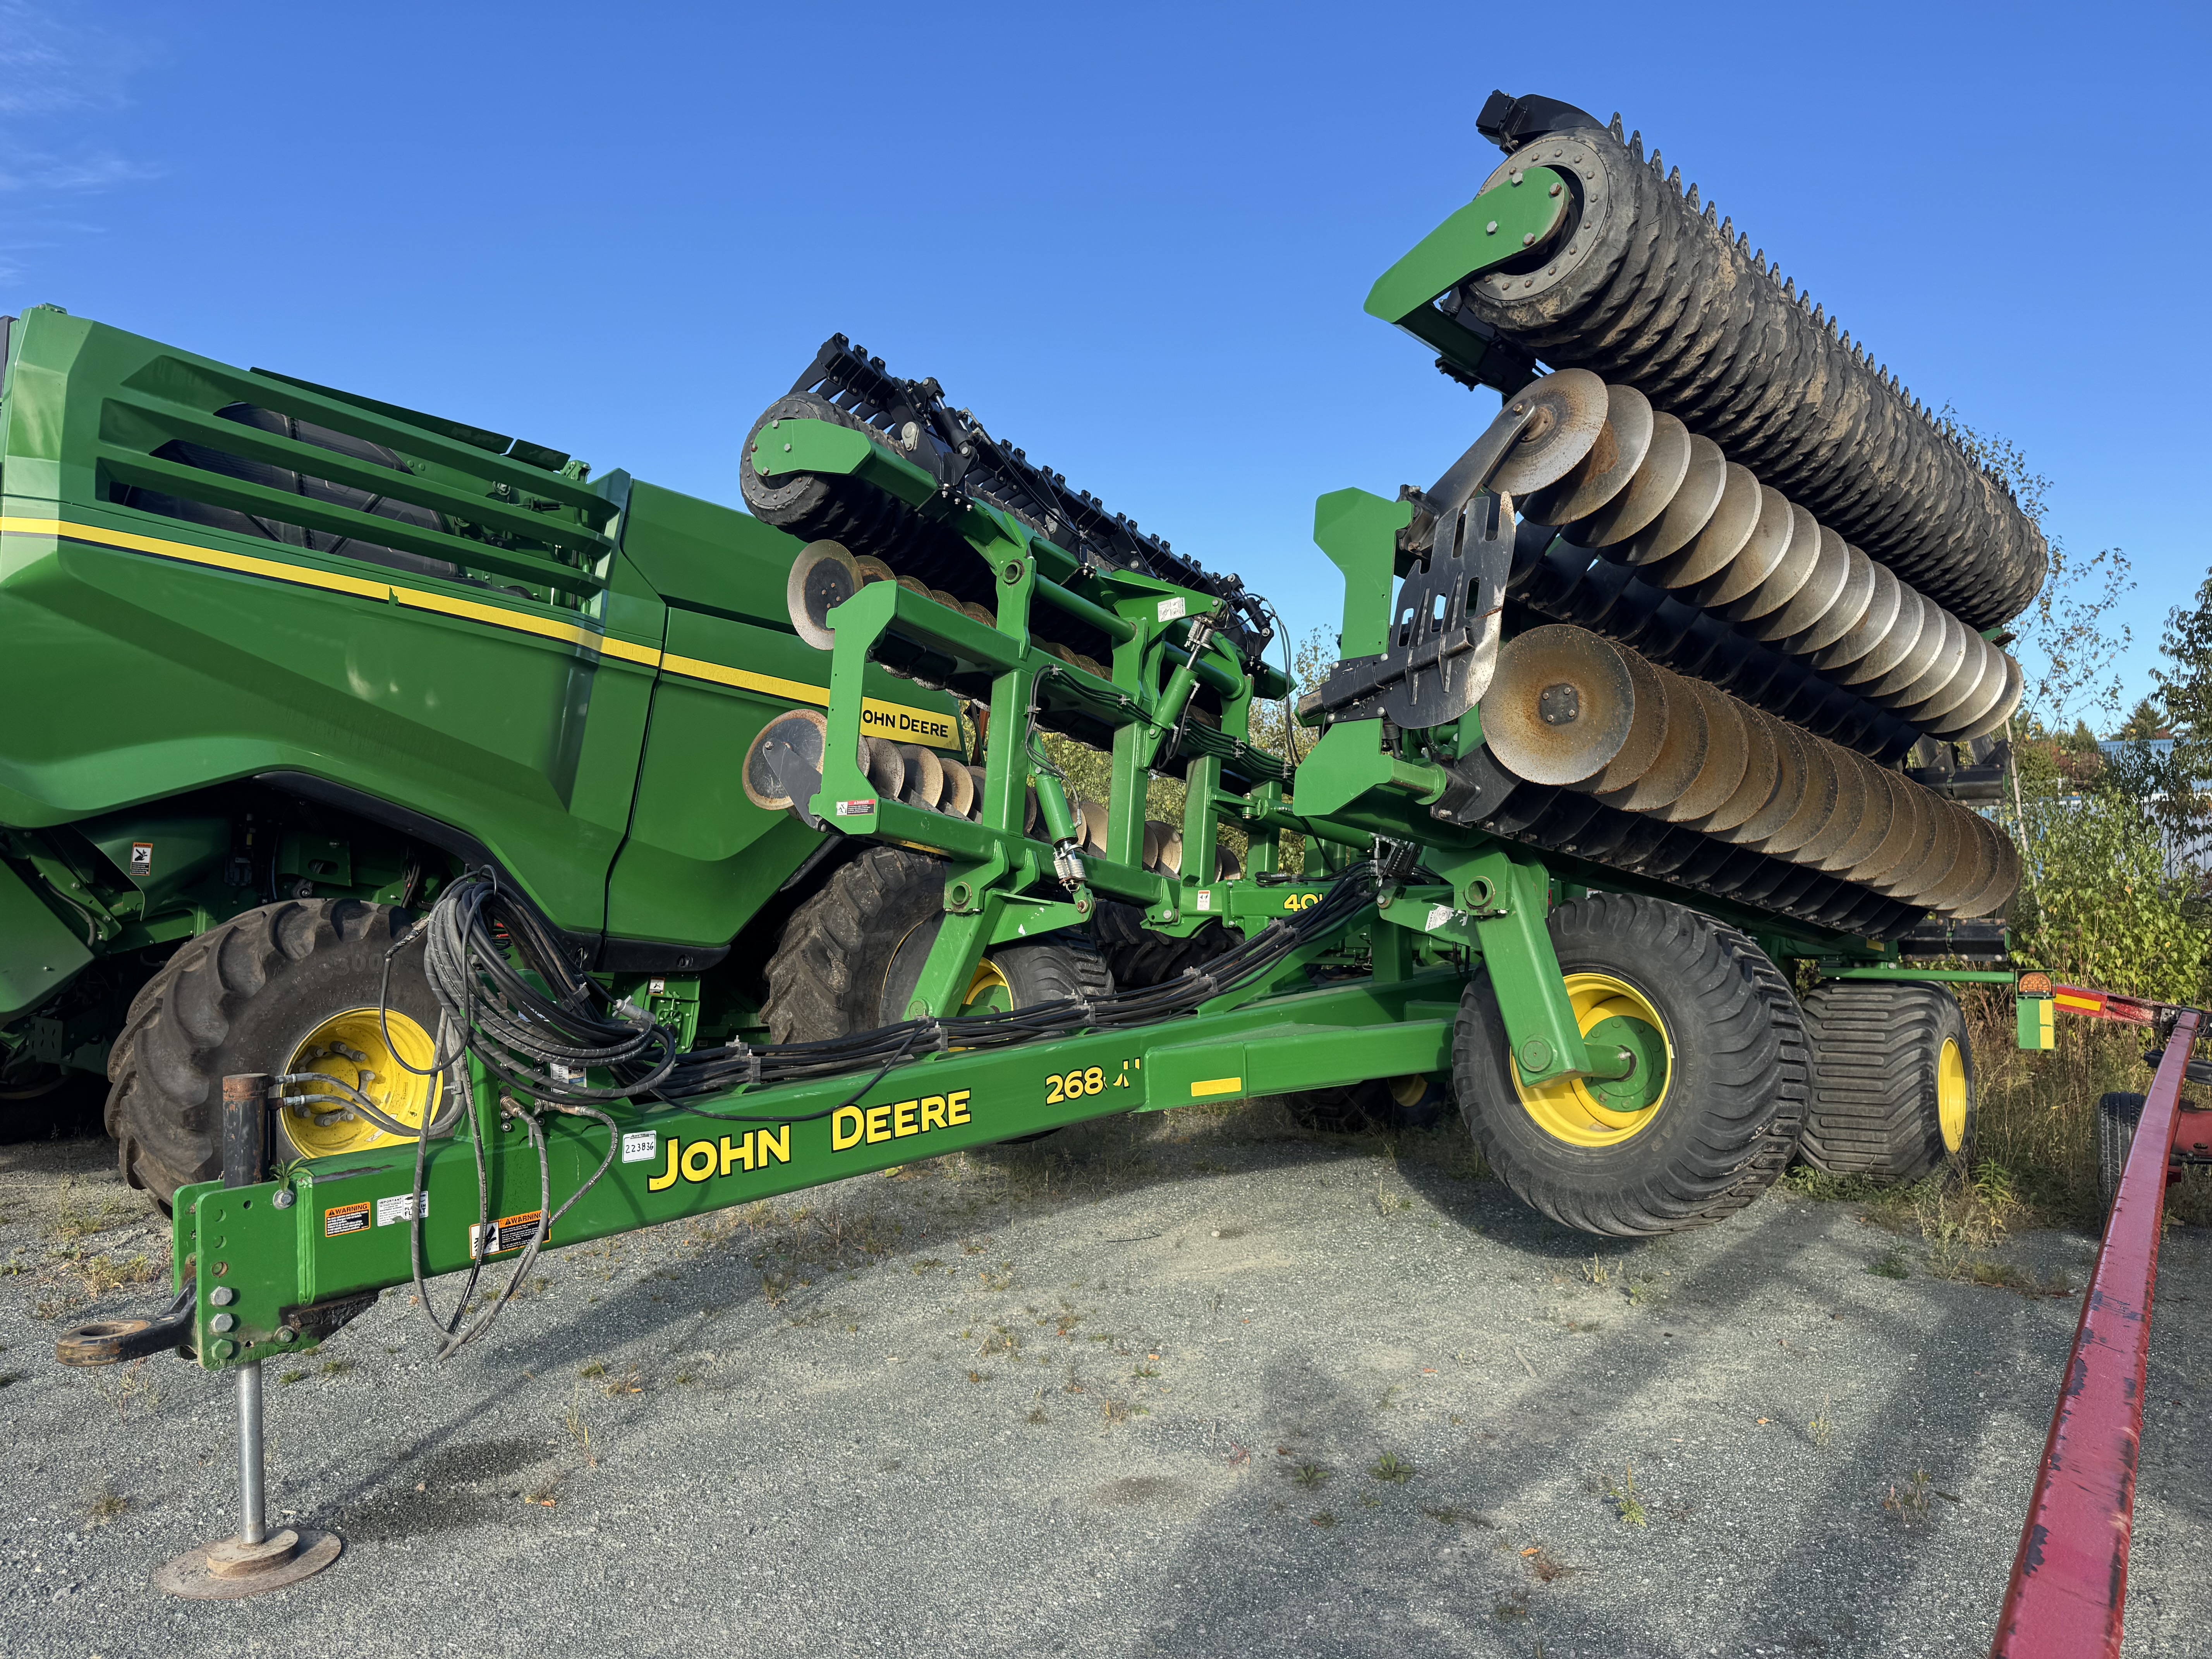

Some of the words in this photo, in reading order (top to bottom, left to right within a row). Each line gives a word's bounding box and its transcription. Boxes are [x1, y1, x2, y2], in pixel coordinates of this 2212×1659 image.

[862, 709, 896, 728] OHN
[899, 713, 948, 738] DEERE
[1045, 1058, 1140, 1105] 268
[625, 1142, 654, 1154] 223836
[649, 1124, 790, 1192] JOHN
[832, 1089, 972, 1152] DEERE
[335, 1204, 368, 1214] WARNING
[404, 1208, 426, 1216] FLAT
